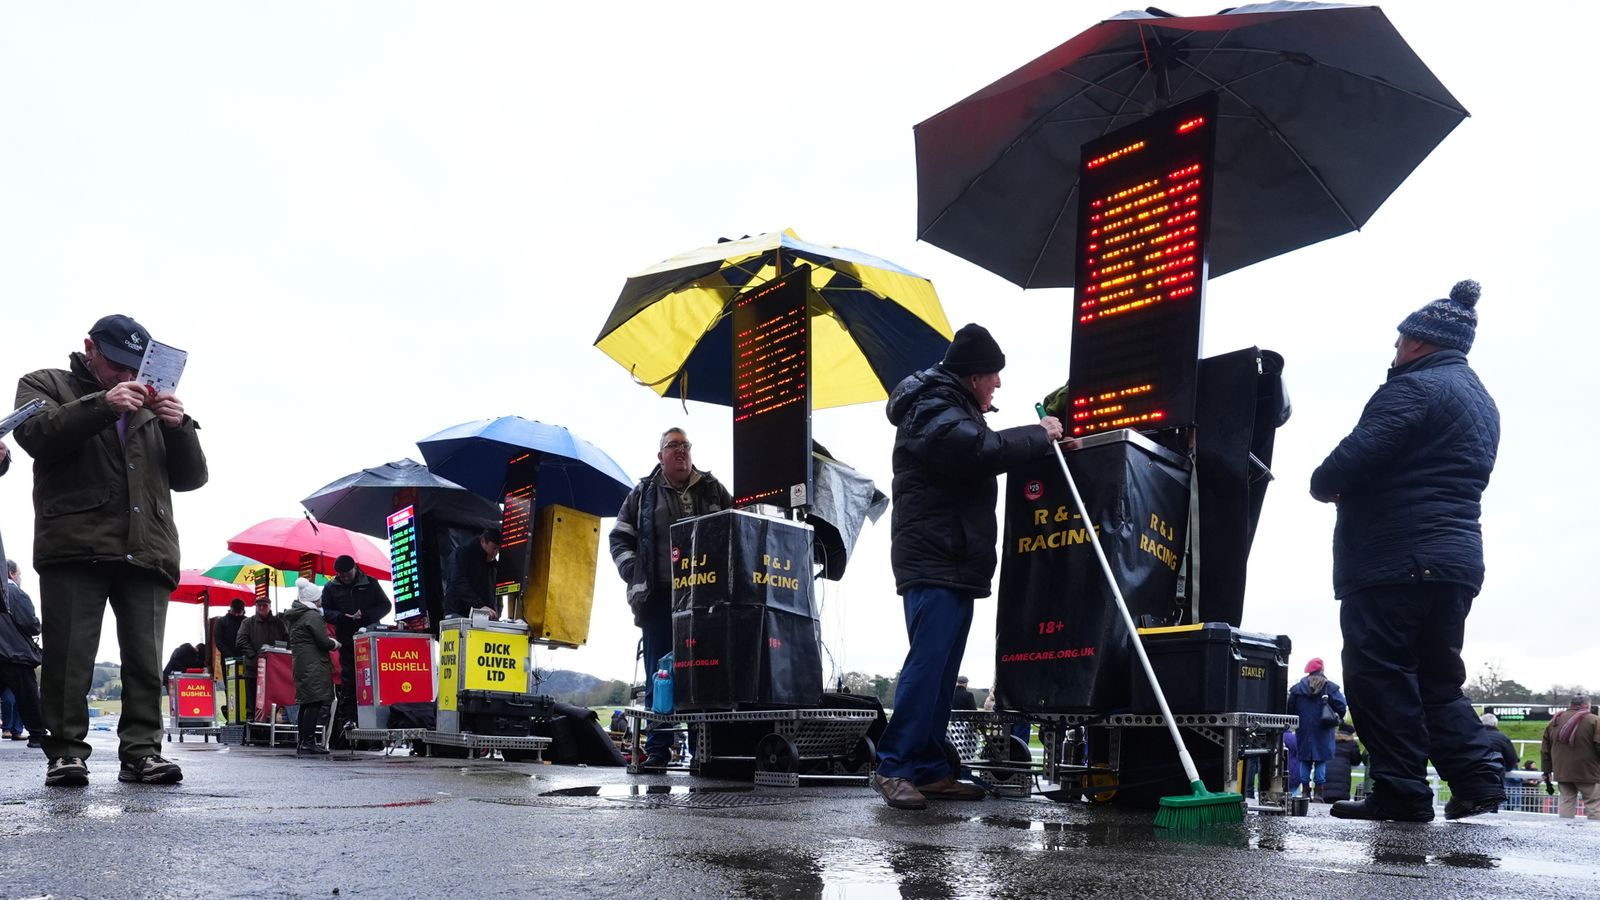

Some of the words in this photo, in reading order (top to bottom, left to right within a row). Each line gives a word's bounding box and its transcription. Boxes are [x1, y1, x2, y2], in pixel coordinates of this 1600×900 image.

[1034, 509, 1049, 526] R
[1054, 505, 1069, 522] &
[1150, 513, 1159, 532] R
[1159, 520, 1167, 536] &
[1167, 526, 1174, 541] J
[1139, 533, 1177, 571] RACING
[681, 558, 689, 570] R
[700, 553, 707, 567] J
[763, 554, 771, 566] R
[772, 557, 781, 569] &
[783, 560, 791, 571] J
[673, 572, 716, 589] RACING
[752, 571, 799, 591] RACING
[1038, 620, 1064, 635] 18+
[444, 641, 455, 652] DICK
[484, 642, 511, 655] DICK
[390, 650, 419, 660] ALAN
[1001, 647, 1095, 662] GAMECARE.ORG.UK
[381, 662, 429, 671] BUSHELL
[477, 656, 516, 669] OLIVER
[487, 670, 505, 682] LTD
[1241, 666, 1266, 678] STANLEY
